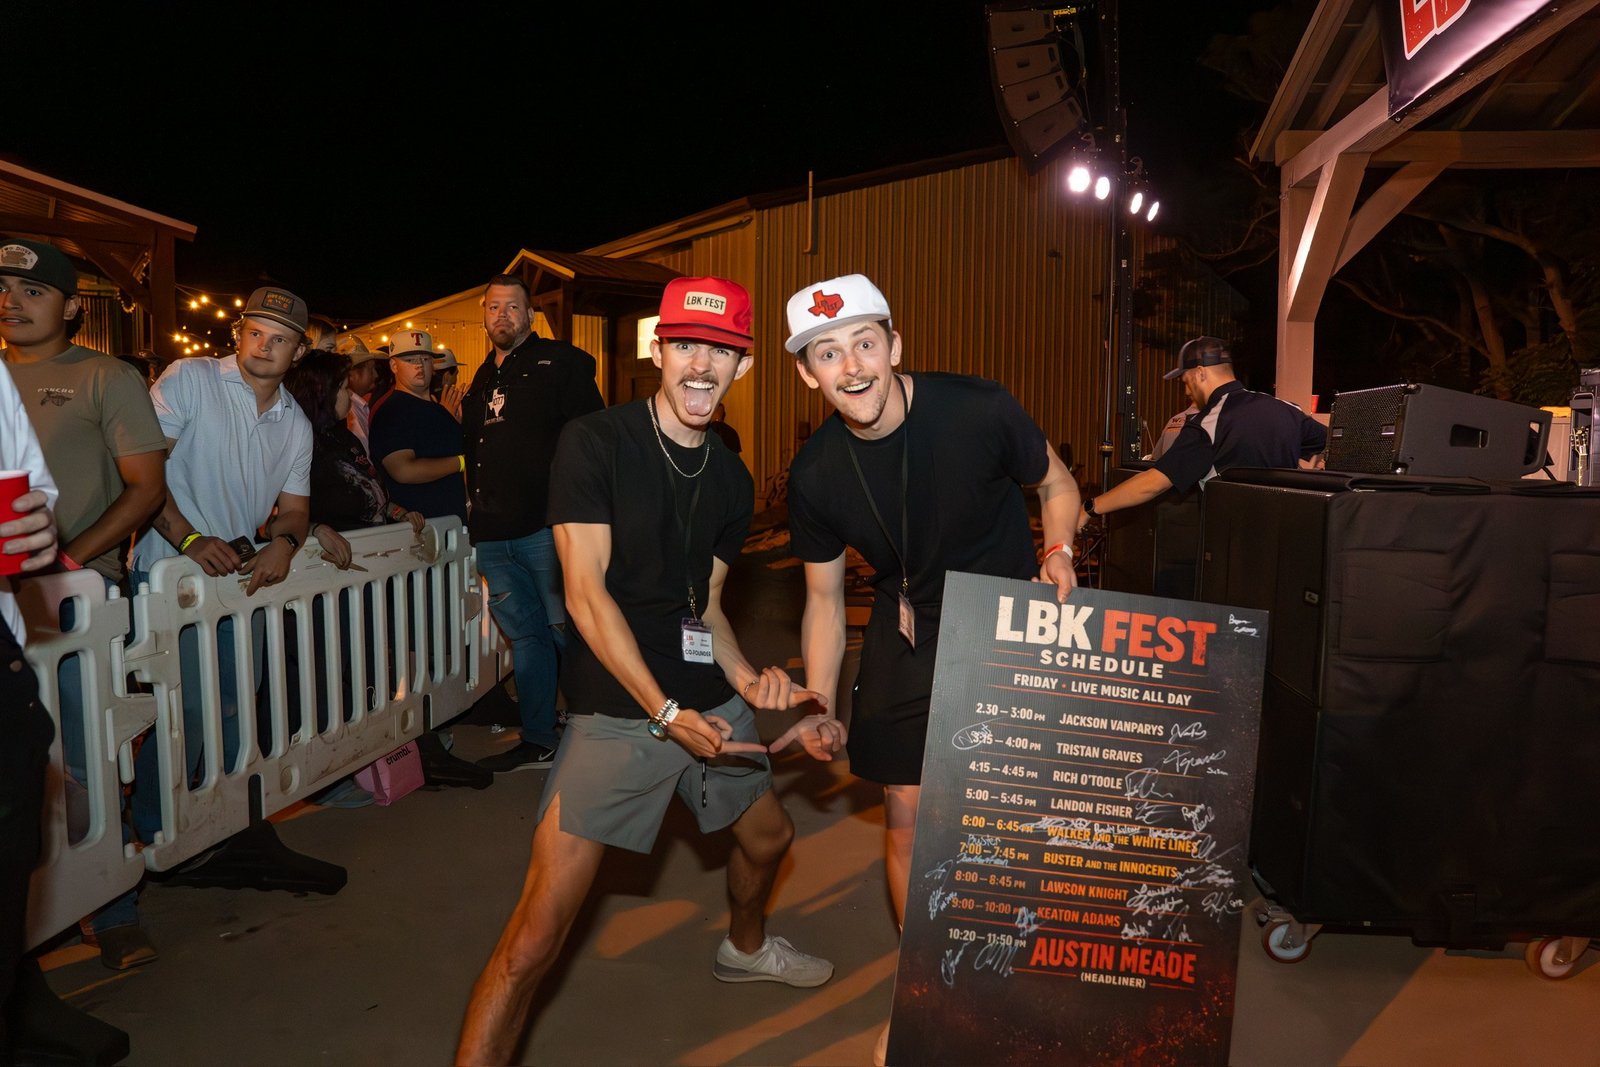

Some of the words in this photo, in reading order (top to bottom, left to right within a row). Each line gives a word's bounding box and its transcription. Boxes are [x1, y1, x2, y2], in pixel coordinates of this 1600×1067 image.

[686, 296, 703, 306] LBK
[704, 297, 725, 310] FEST
[410, 333, 424, 346] T
[995, 595, 1094, 650] LBK
[1101, 609, 1217, 666] FEST
[1040, 649, 1165, 679] SCHEDULE
[1013, 673, 1059, 690] FRIDAY
[1071, 680, 1098, 695] LIVE
[1100, 684, 1140, 700] MUSIC
[1142, 689, 1164, 704] ALL
[1167, 692, 1192, 706] DAY
[1010, 707, 1033, 720] 3:00
[1034, 713, 1045, 721] PM
[1059, 713, 1108, 730] JACKSON
[1110, 720, 1164, 736] VANPARYS
[1005, 736, 1029, 750] 4:00
[1030, 742, 1041, 751] PM
[1056, 742, 1100, 758] TRISTAN
[1102, 748, 1143, 764] GRAVES
[969, 761, 990, 773] 4:15
[1002, 764, 1025, 778] 4:45
[1026, 771, 1038, 779] PM
[1053, 770, 1078, 785] RICH
[1080, 773, 1123, 789] O'TOOLE
[965, 788, 989, 801] 5:00
[1000, 792, 1023, 805] 5:45
[1024, 798, 1036, 807] PM
[1050, 798, 1093, 814] LANDON
[1095, 803, 1133, 819] FISHER
[962, 815, 986, 828] 6:00
[996, 819, 1020, 832] 6:45
[1047, 826, 1090, 841] WALKER
[1093, 832, 1111, 843] AND
[1113, 836, 1129, 846] THE
[1132, 836, 1166, 850] WHITE
[1168, 839, 1198, 853] LINES
[960, 841, 982, 855] 7:00
[993, 846, 1016, 859] 7:45
[1017, 852, 1029, 861] PM
[1043, 852, 1084, 867] BUSTER
[1085, 859, 1102, 869] AND
[1103, 862, 1117, 871] THE
[1119, 861, 1178, 878] INNOCENTS
[955, 870, 978, 883] 8:00
[989, 874, 1012, 888] 8:45
[1014, 880, 1026, 889] PM
[1040, 879, 1086, 896] LAWSON
[1088, 888, 1129, 901] KNIGHT
[951, 897, 975, 910] 9:00
[985, 901, 1011, 914] 10:00
[1037, 906, 1079, 923] KEATON
[1081, 913, 1121, 928] ADAMS
[948, 928, 976, 941] 10:20
[987, 933, 1013, 946] 11:50
[1029, 937, 1115, 971] AUSTIN
[1119, 945, 1198, 984] MEADE
[1080, 971, 1146, 989] (HEADLINER)
